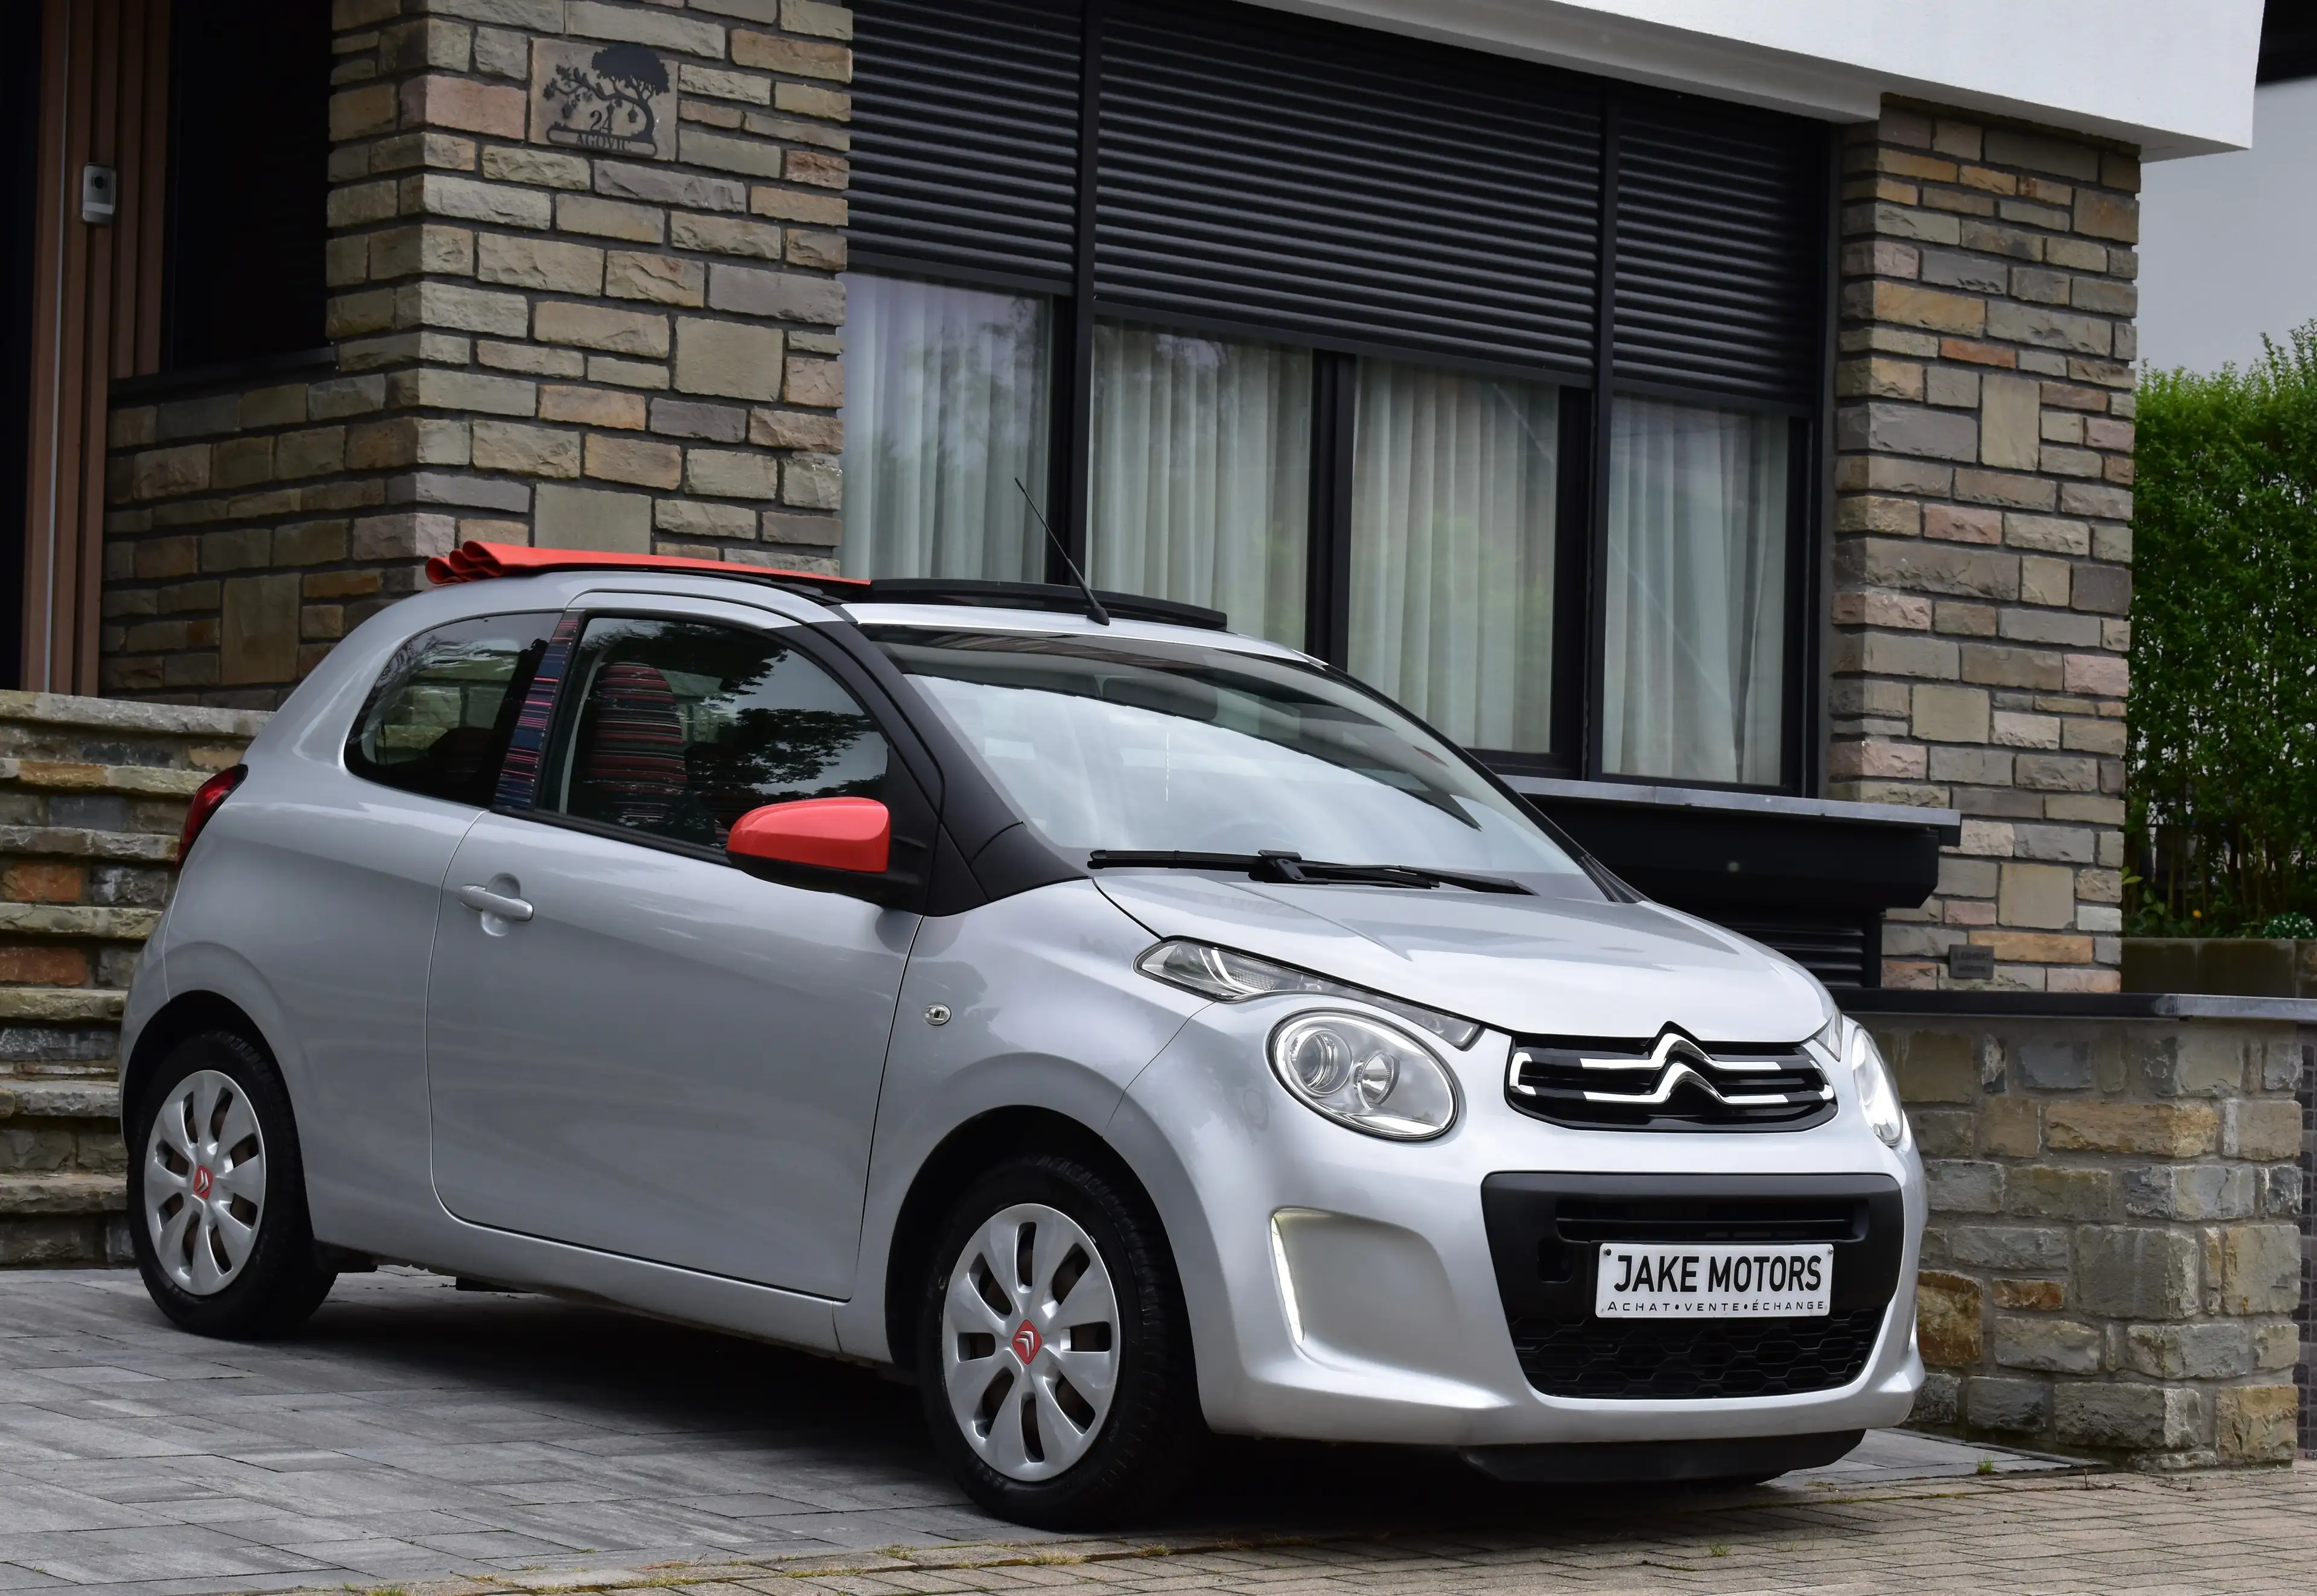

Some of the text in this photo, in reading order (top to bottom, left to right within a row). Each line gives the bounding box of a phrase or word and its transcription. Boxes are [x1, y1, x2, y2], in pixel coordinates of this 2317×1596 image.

[590, 108, 613, 134] 24
[1613, 1255, 1822, 1292] JAKE MOTORS
